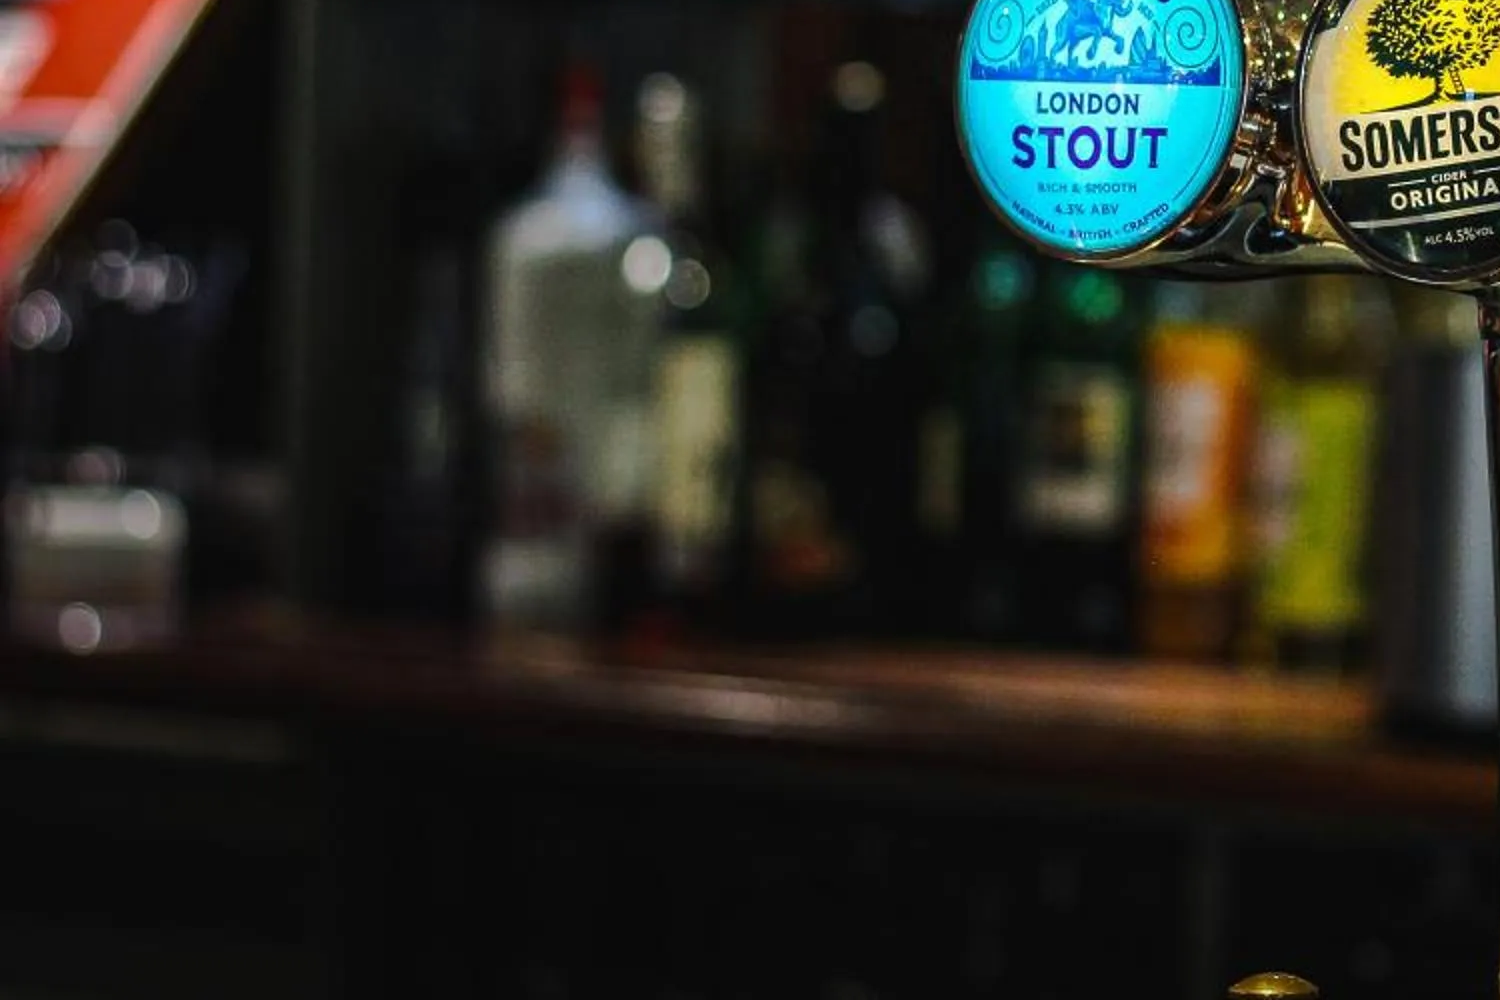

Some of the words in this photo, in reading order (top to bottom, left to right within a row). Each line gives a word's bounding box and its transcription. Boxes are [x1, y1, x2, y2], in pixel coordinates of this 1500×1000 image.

[1036, 91, 1140, 115] LONDON
[1011, 124, 1168, 169] STOUT
[1431, 169, 1467, 184] CIDER
[1037, 182, 1067, 194] RICH
[1085, 182, 1138, 194] SMOOTH
[1055, 203, 1084, 216] 4.3%
[1090, 203, 1120, 216] ABV
[1122, 202, 1170, 233] CRAFTED
